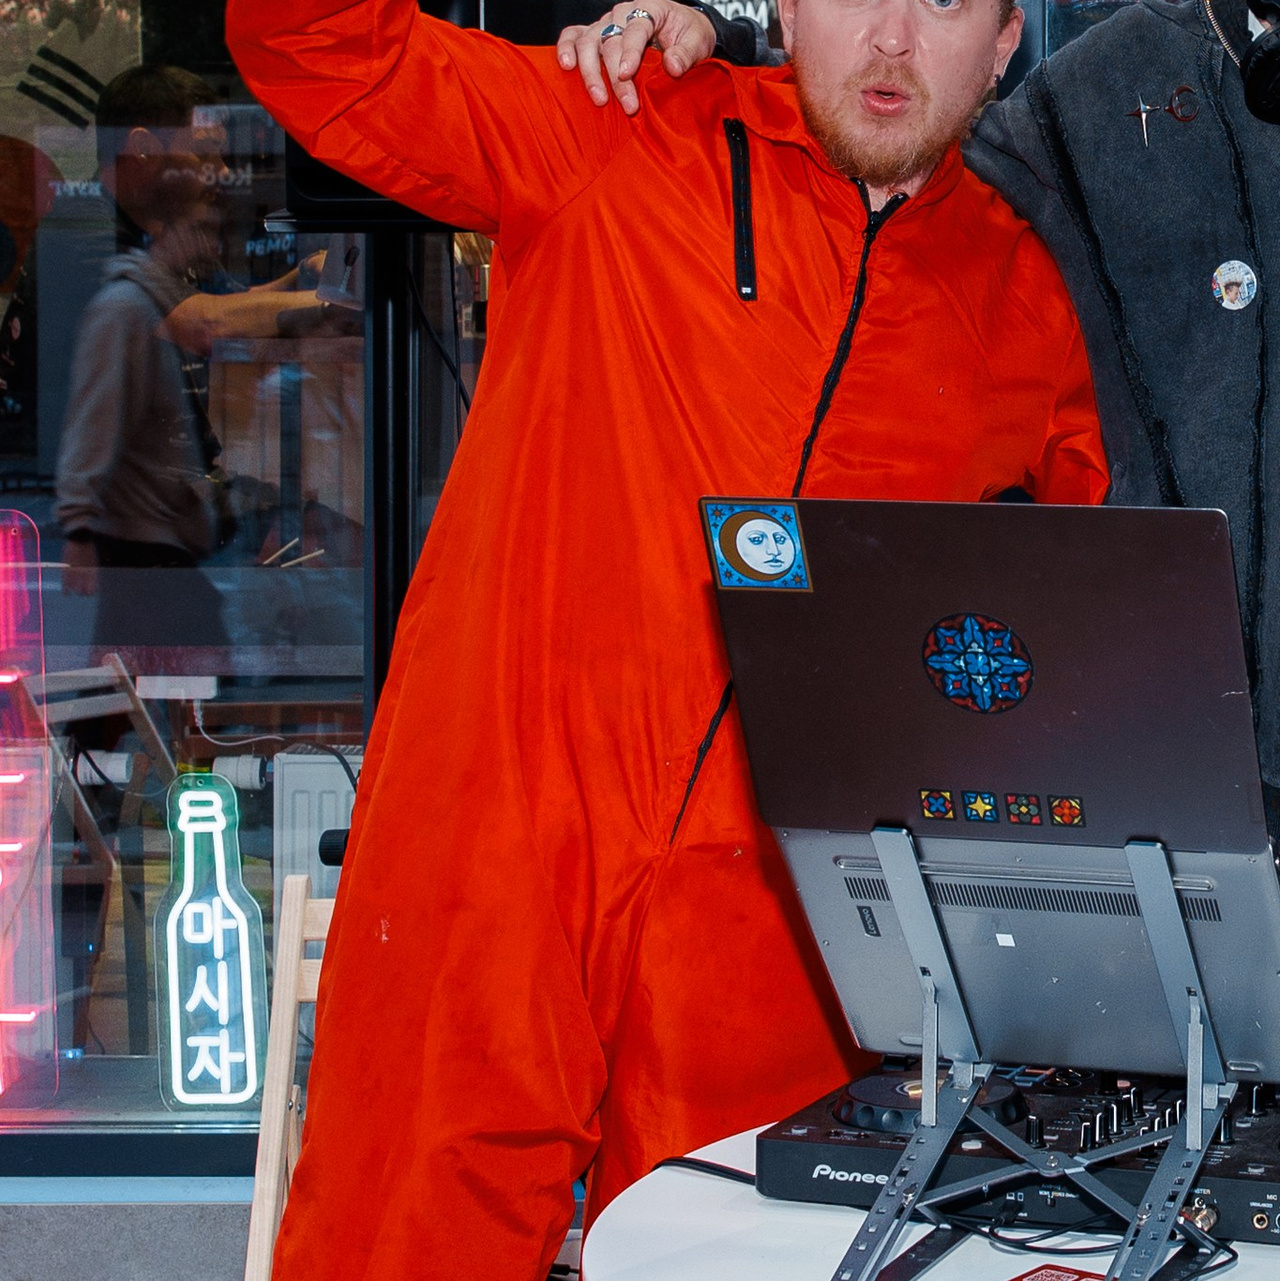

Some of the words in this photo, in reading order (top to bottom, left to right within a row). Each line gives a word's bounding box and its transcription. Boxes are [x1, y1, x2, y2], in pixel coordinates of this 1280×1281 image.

[861, 908, 877, 935] Lenovo
[183, 896, 245, 1094] 마시자
[812, 1164, 889, 1184] Pionee
